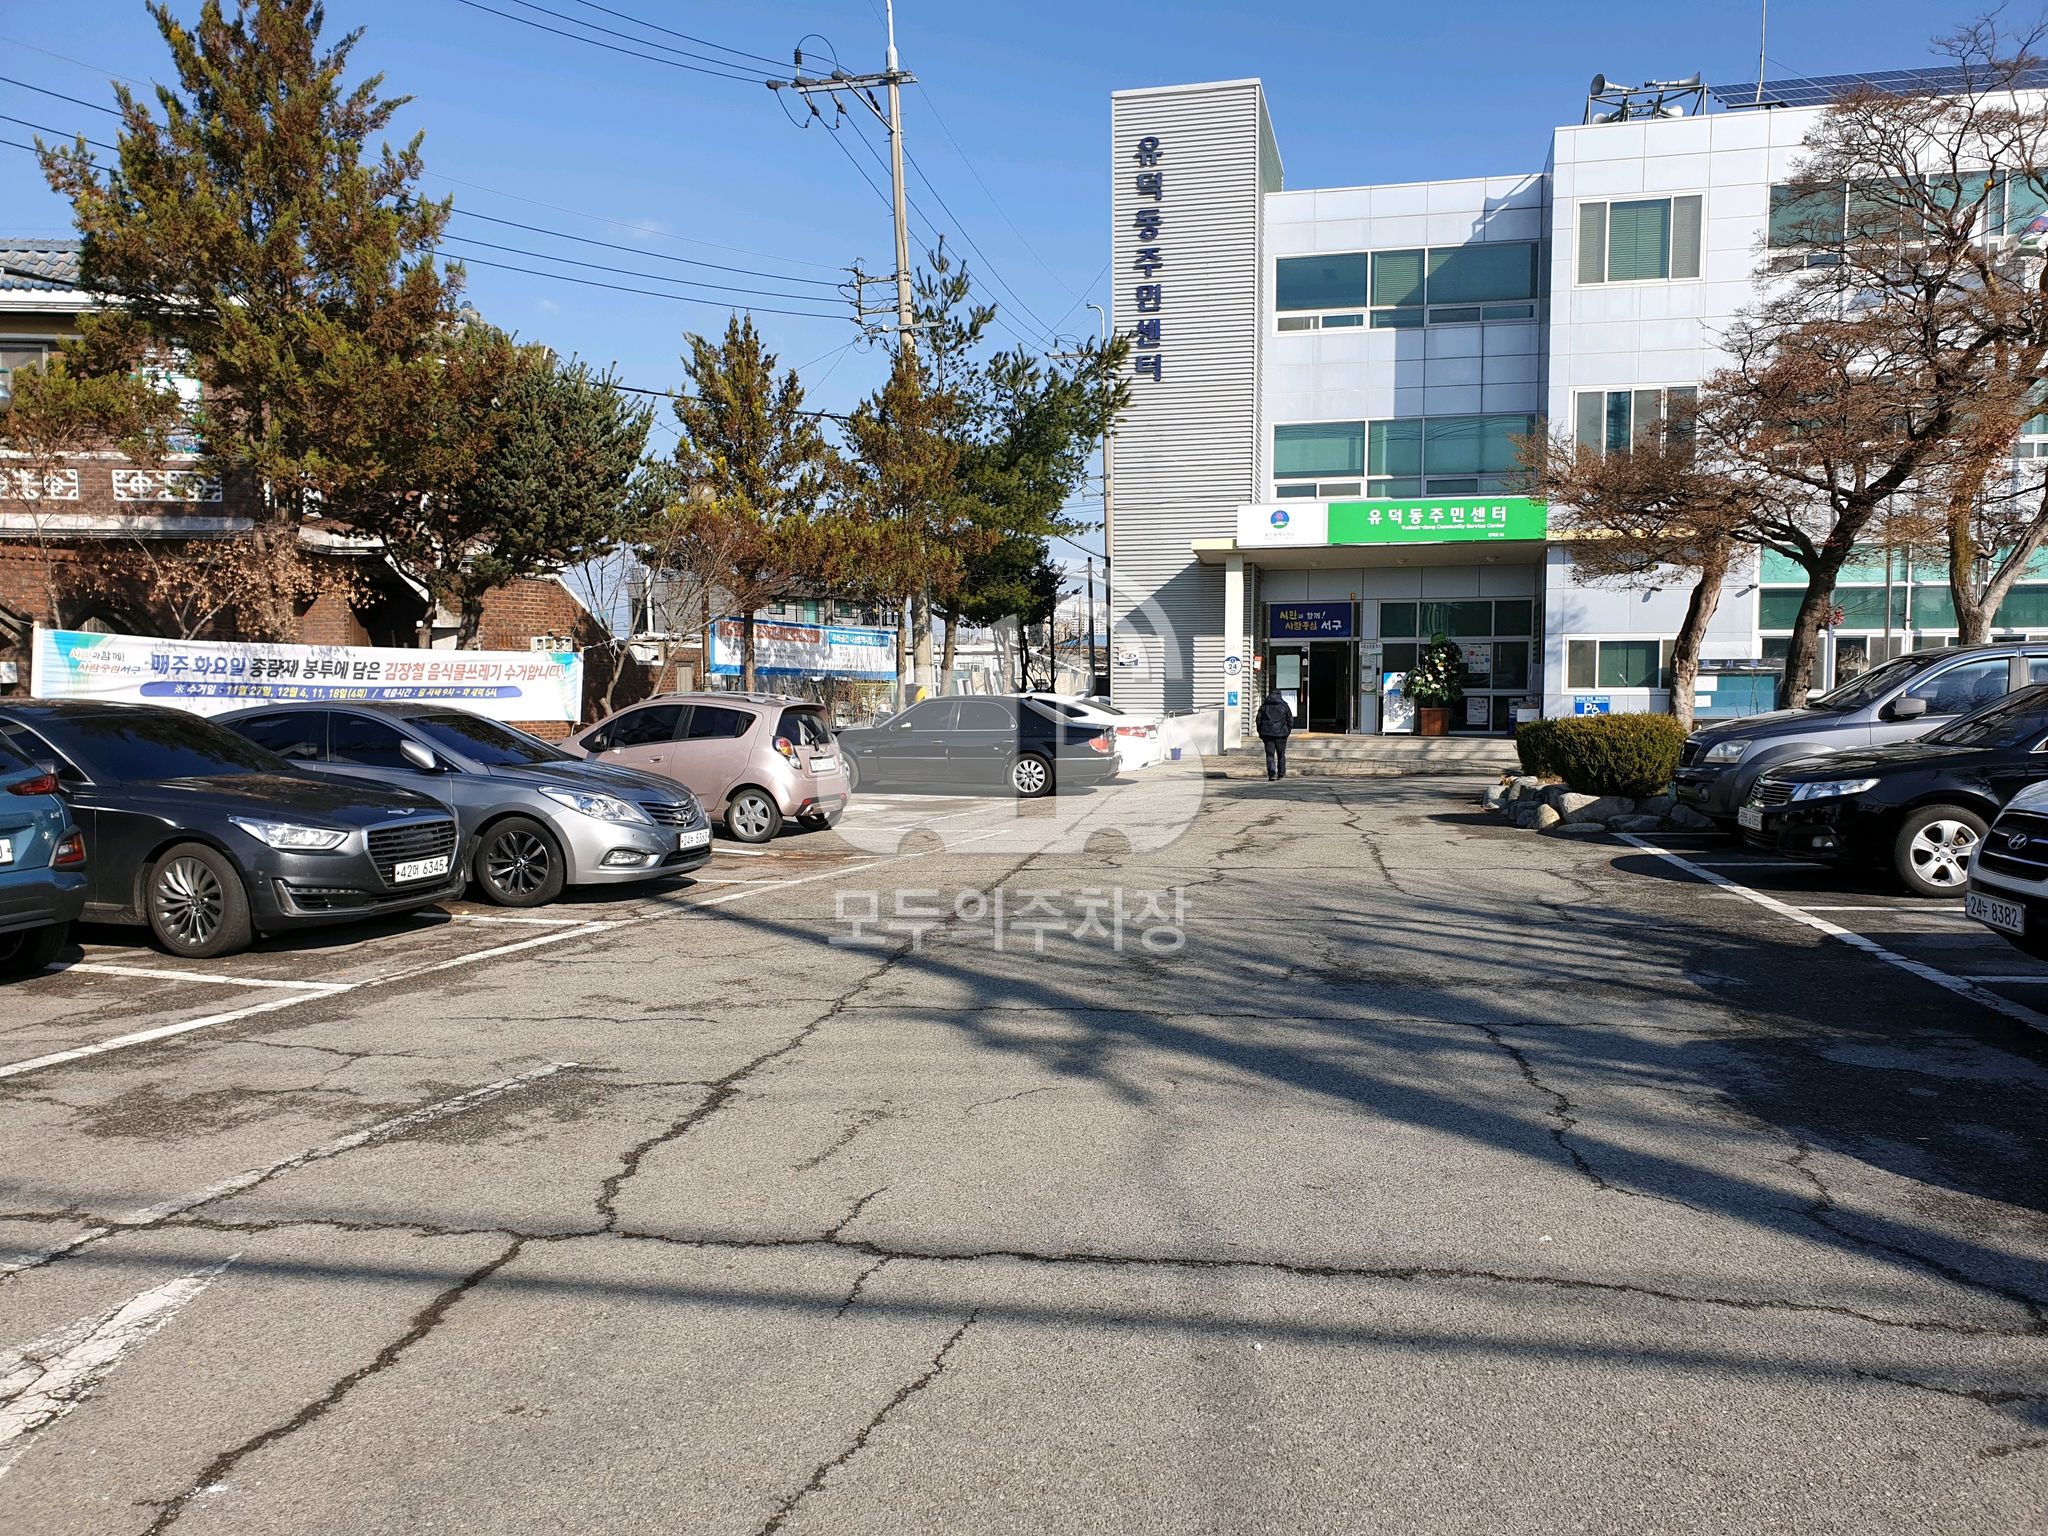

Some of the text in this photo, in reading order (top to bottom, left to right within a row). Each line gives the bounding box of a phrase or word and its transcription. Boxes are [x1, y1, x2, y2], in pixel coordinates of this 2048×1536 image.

[1133, 135, 1164, 383] 유덕동주민센터
[1366, 505, 1508, 526] 유덕동주민센터
[1321, 619, 1342, 631] 서구
[151, 654, 189, 675] 매주
[193, 656, 246, 677] 화요일
[250, 657, 299, 678] 종량제
[302, 659, 349, 680] 봉투에
[352, 661, 381, 680] 담은
[385, 662, 426, 682] 김장철
[427, 662, 503, 681] 음식물쓰레기
[226, 684, 247, 697] 11월
[278, 686, 299, 698] 12월
[422, 859, 444, 876] 6345
[1971, 896, 2018, 929] 24누 8382
